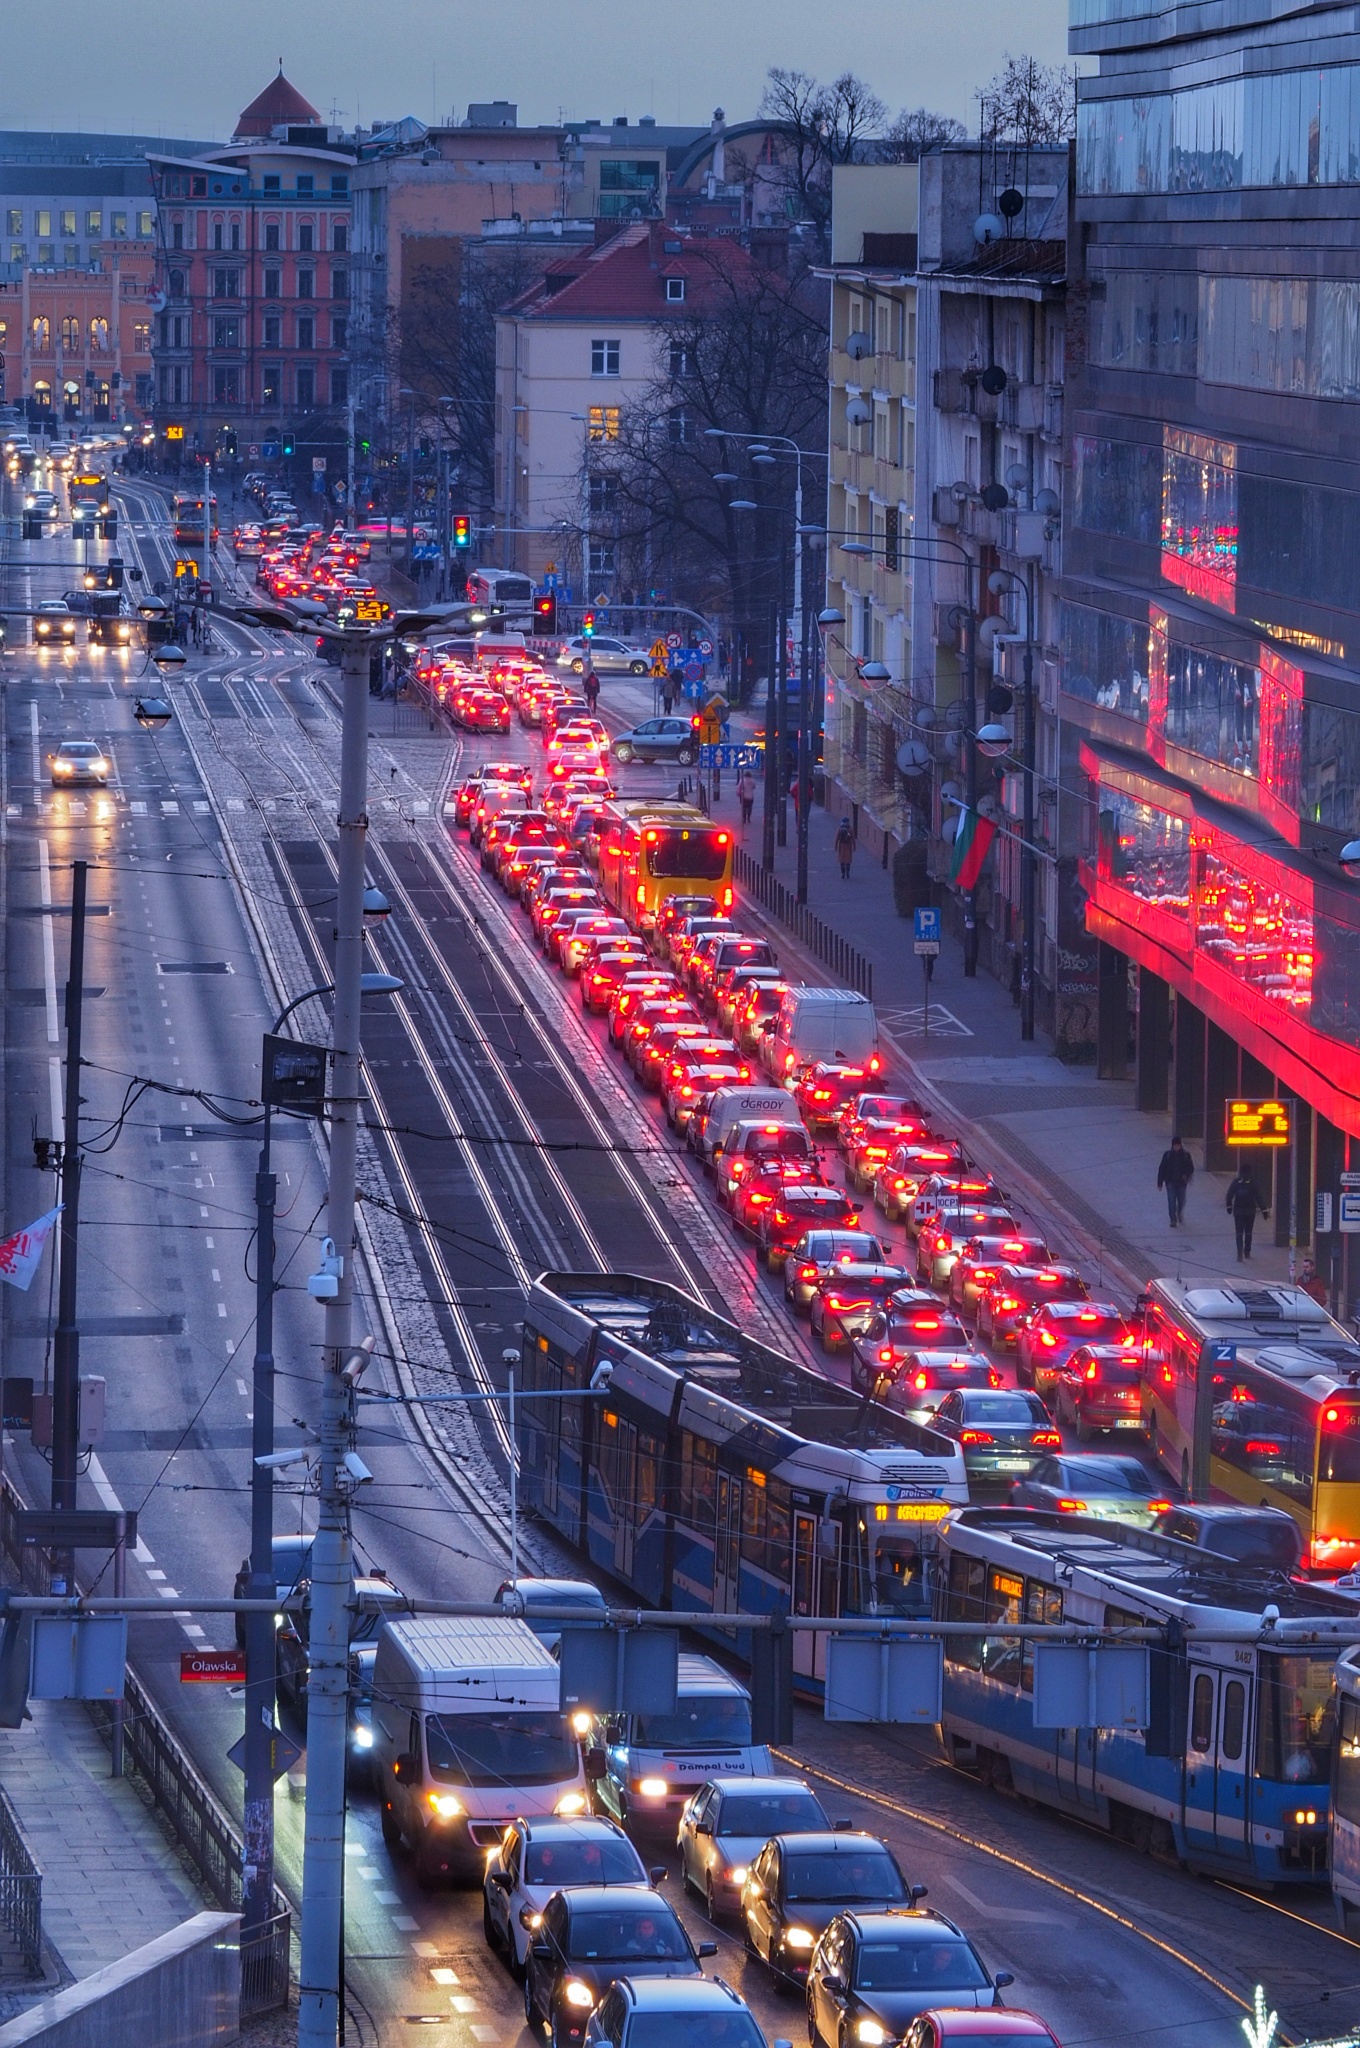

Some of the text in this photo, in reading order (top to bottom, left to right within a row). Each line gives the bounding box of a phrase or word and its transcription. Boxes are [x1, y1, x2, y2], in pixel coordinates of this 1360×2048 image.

[682, 831, 689, 840] D
[920, 911, 935, 931] P
[875, 1505, 887, 1521] 11
[191, 1660, 237, 1672] Oławska
[725, 1762, 745, 1770] bud
